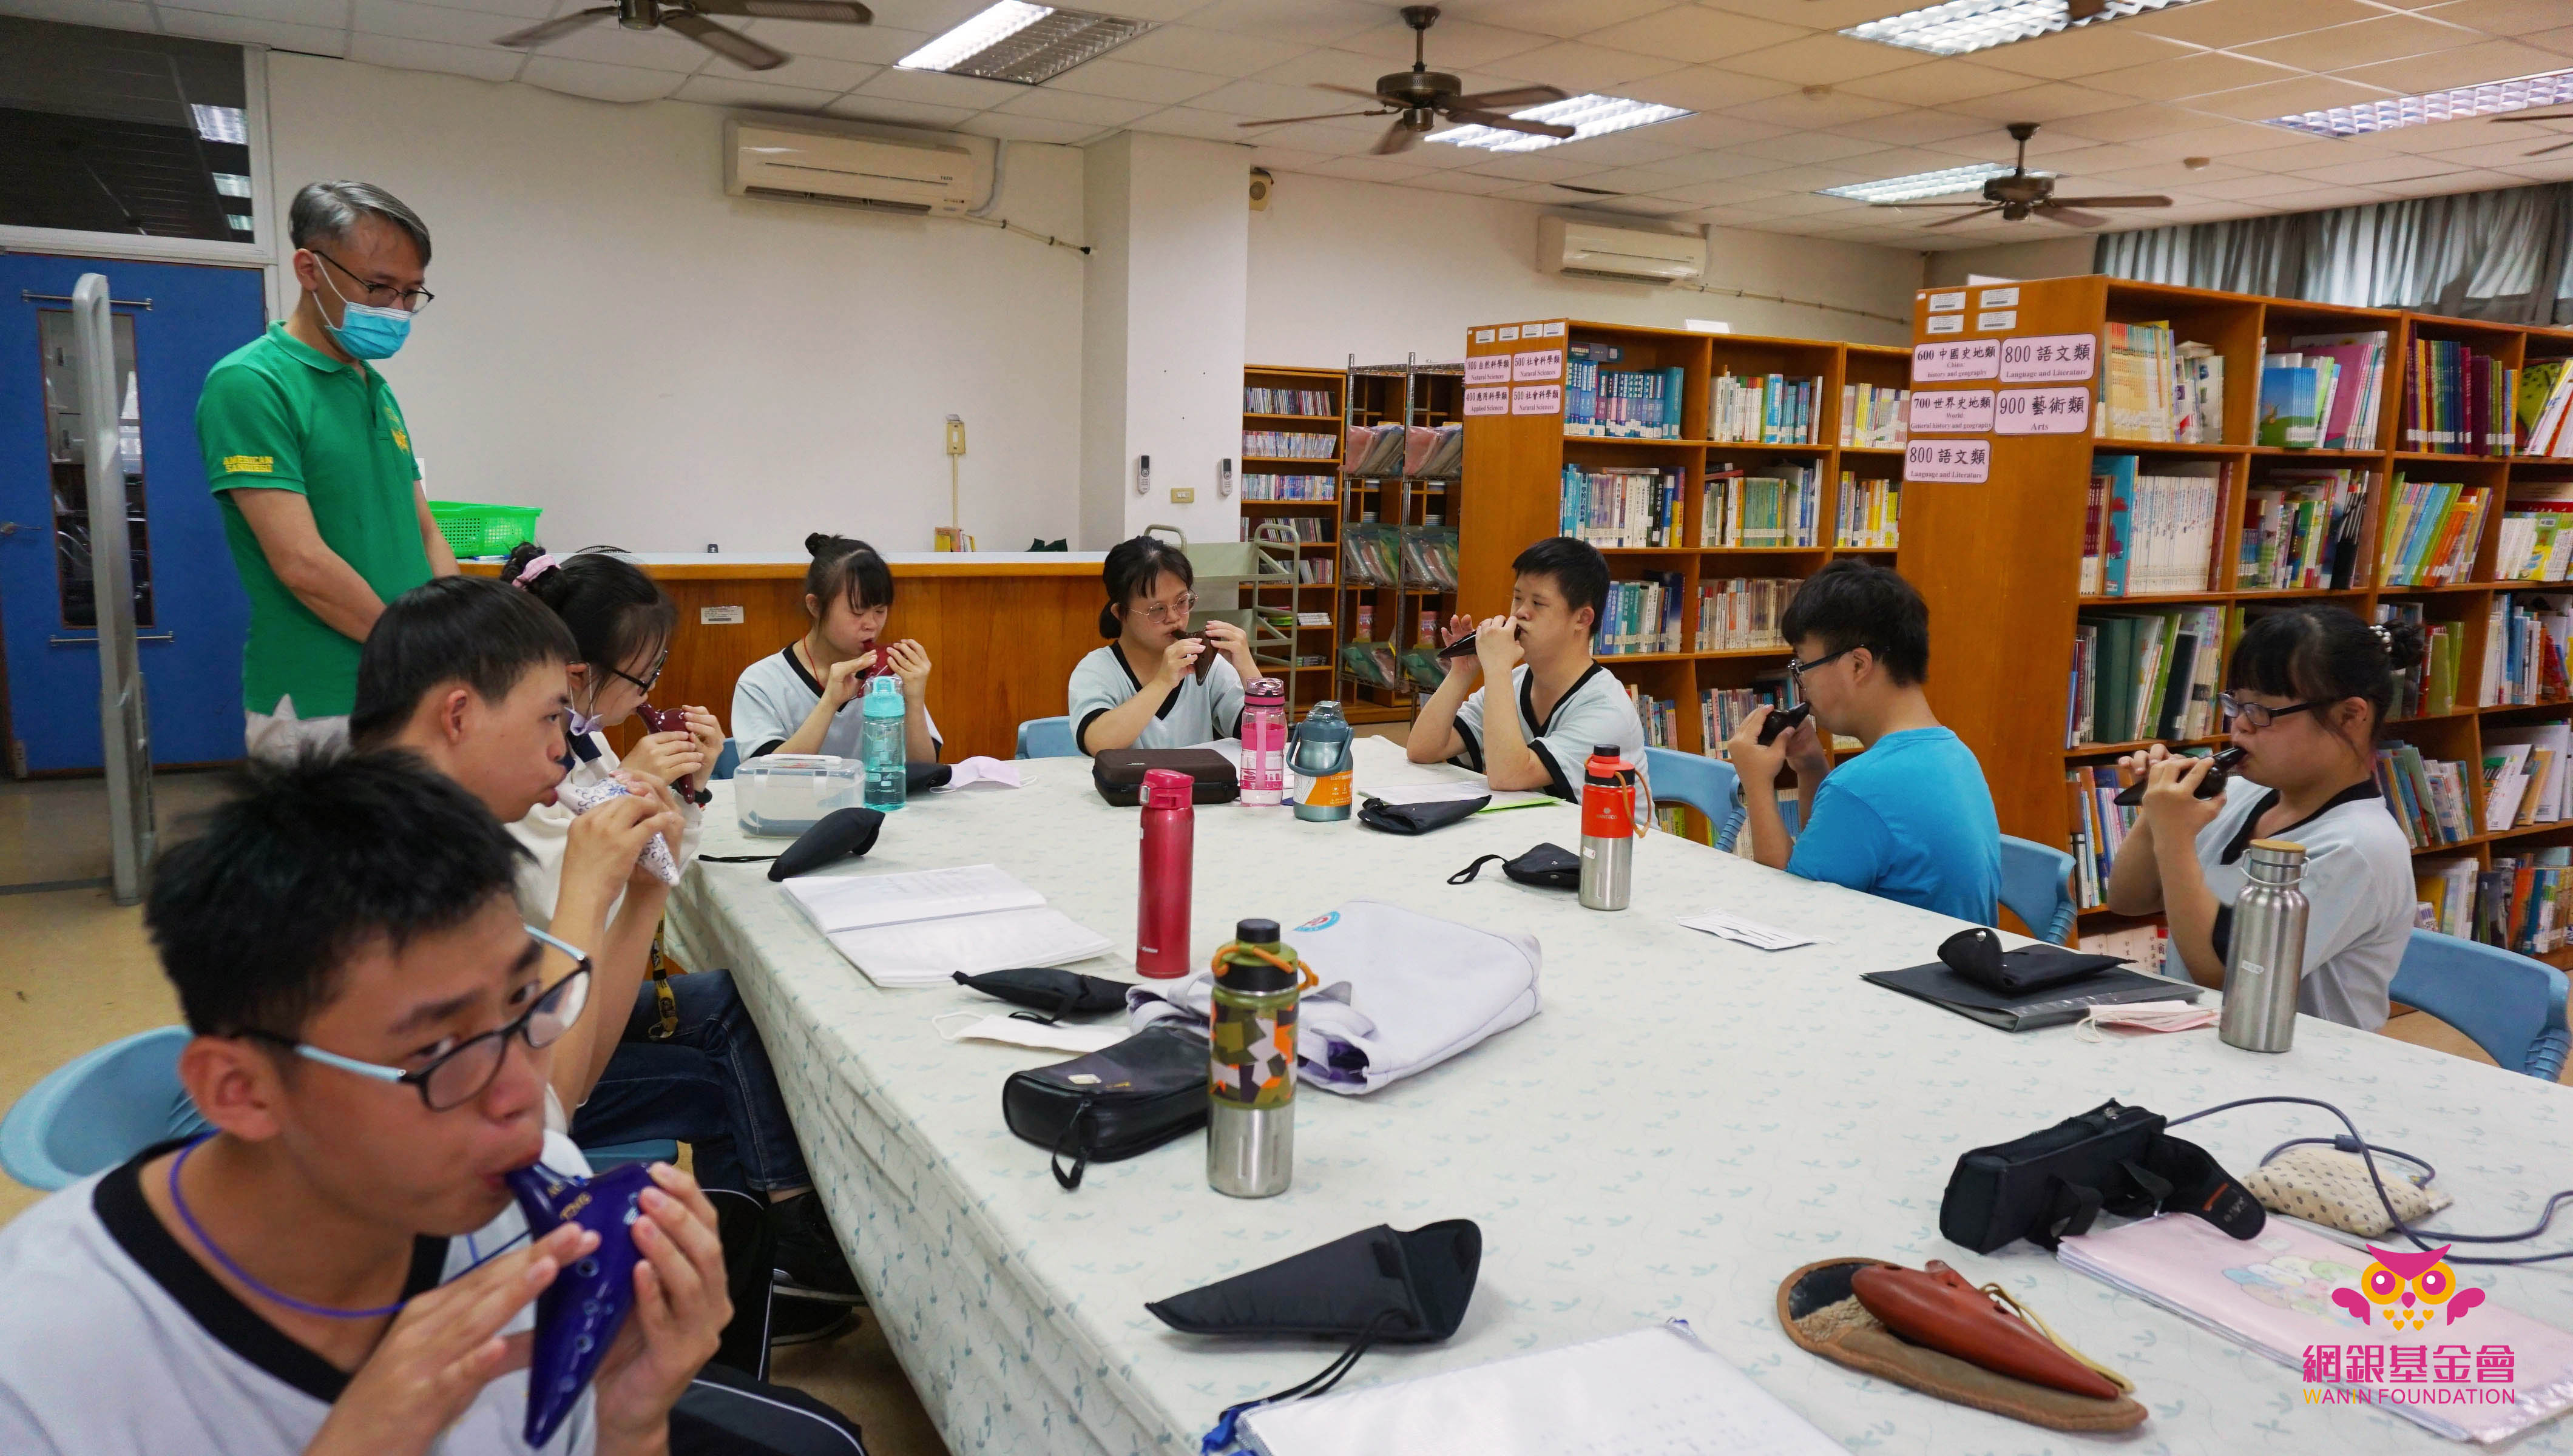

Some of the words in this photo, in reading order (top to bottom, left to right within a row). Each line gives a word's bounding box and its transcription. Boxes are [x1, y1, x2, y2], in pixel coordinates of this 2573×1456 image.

[1917, 349, 1934, 361] 600
[1939, 346, 1996, 360] 中國史地類
[2004, 345, 2031, 363] 800
[2037, 343, 2091, 362] 語文類
[1467, 361, 1476, 369] 300
[1479, 360, 1509, 369] 自然科學類
[1515, 357, 1525, 366] 500
[1526, 355, 1560, 366] 社會科學類
[2053, 368, 2088, 377] Literature
[1466, 393, 1475, 401] 400
[1476, 391, 1507, 401] 應用科學類
[1514, 392, 1524, 400] 500
[1526, 390, 1559, 400] 社會科學類
[1914, 398, 1930, 409] 700
[1933, 396, 1991, 410] 世界史地類
[2000, 397, 2025, 414] 900
[2032, 396, 2084, 415] 藝術類
[1910, 447, 1933, 463] 800
[1938, 448, 1986, 465] 語文類
